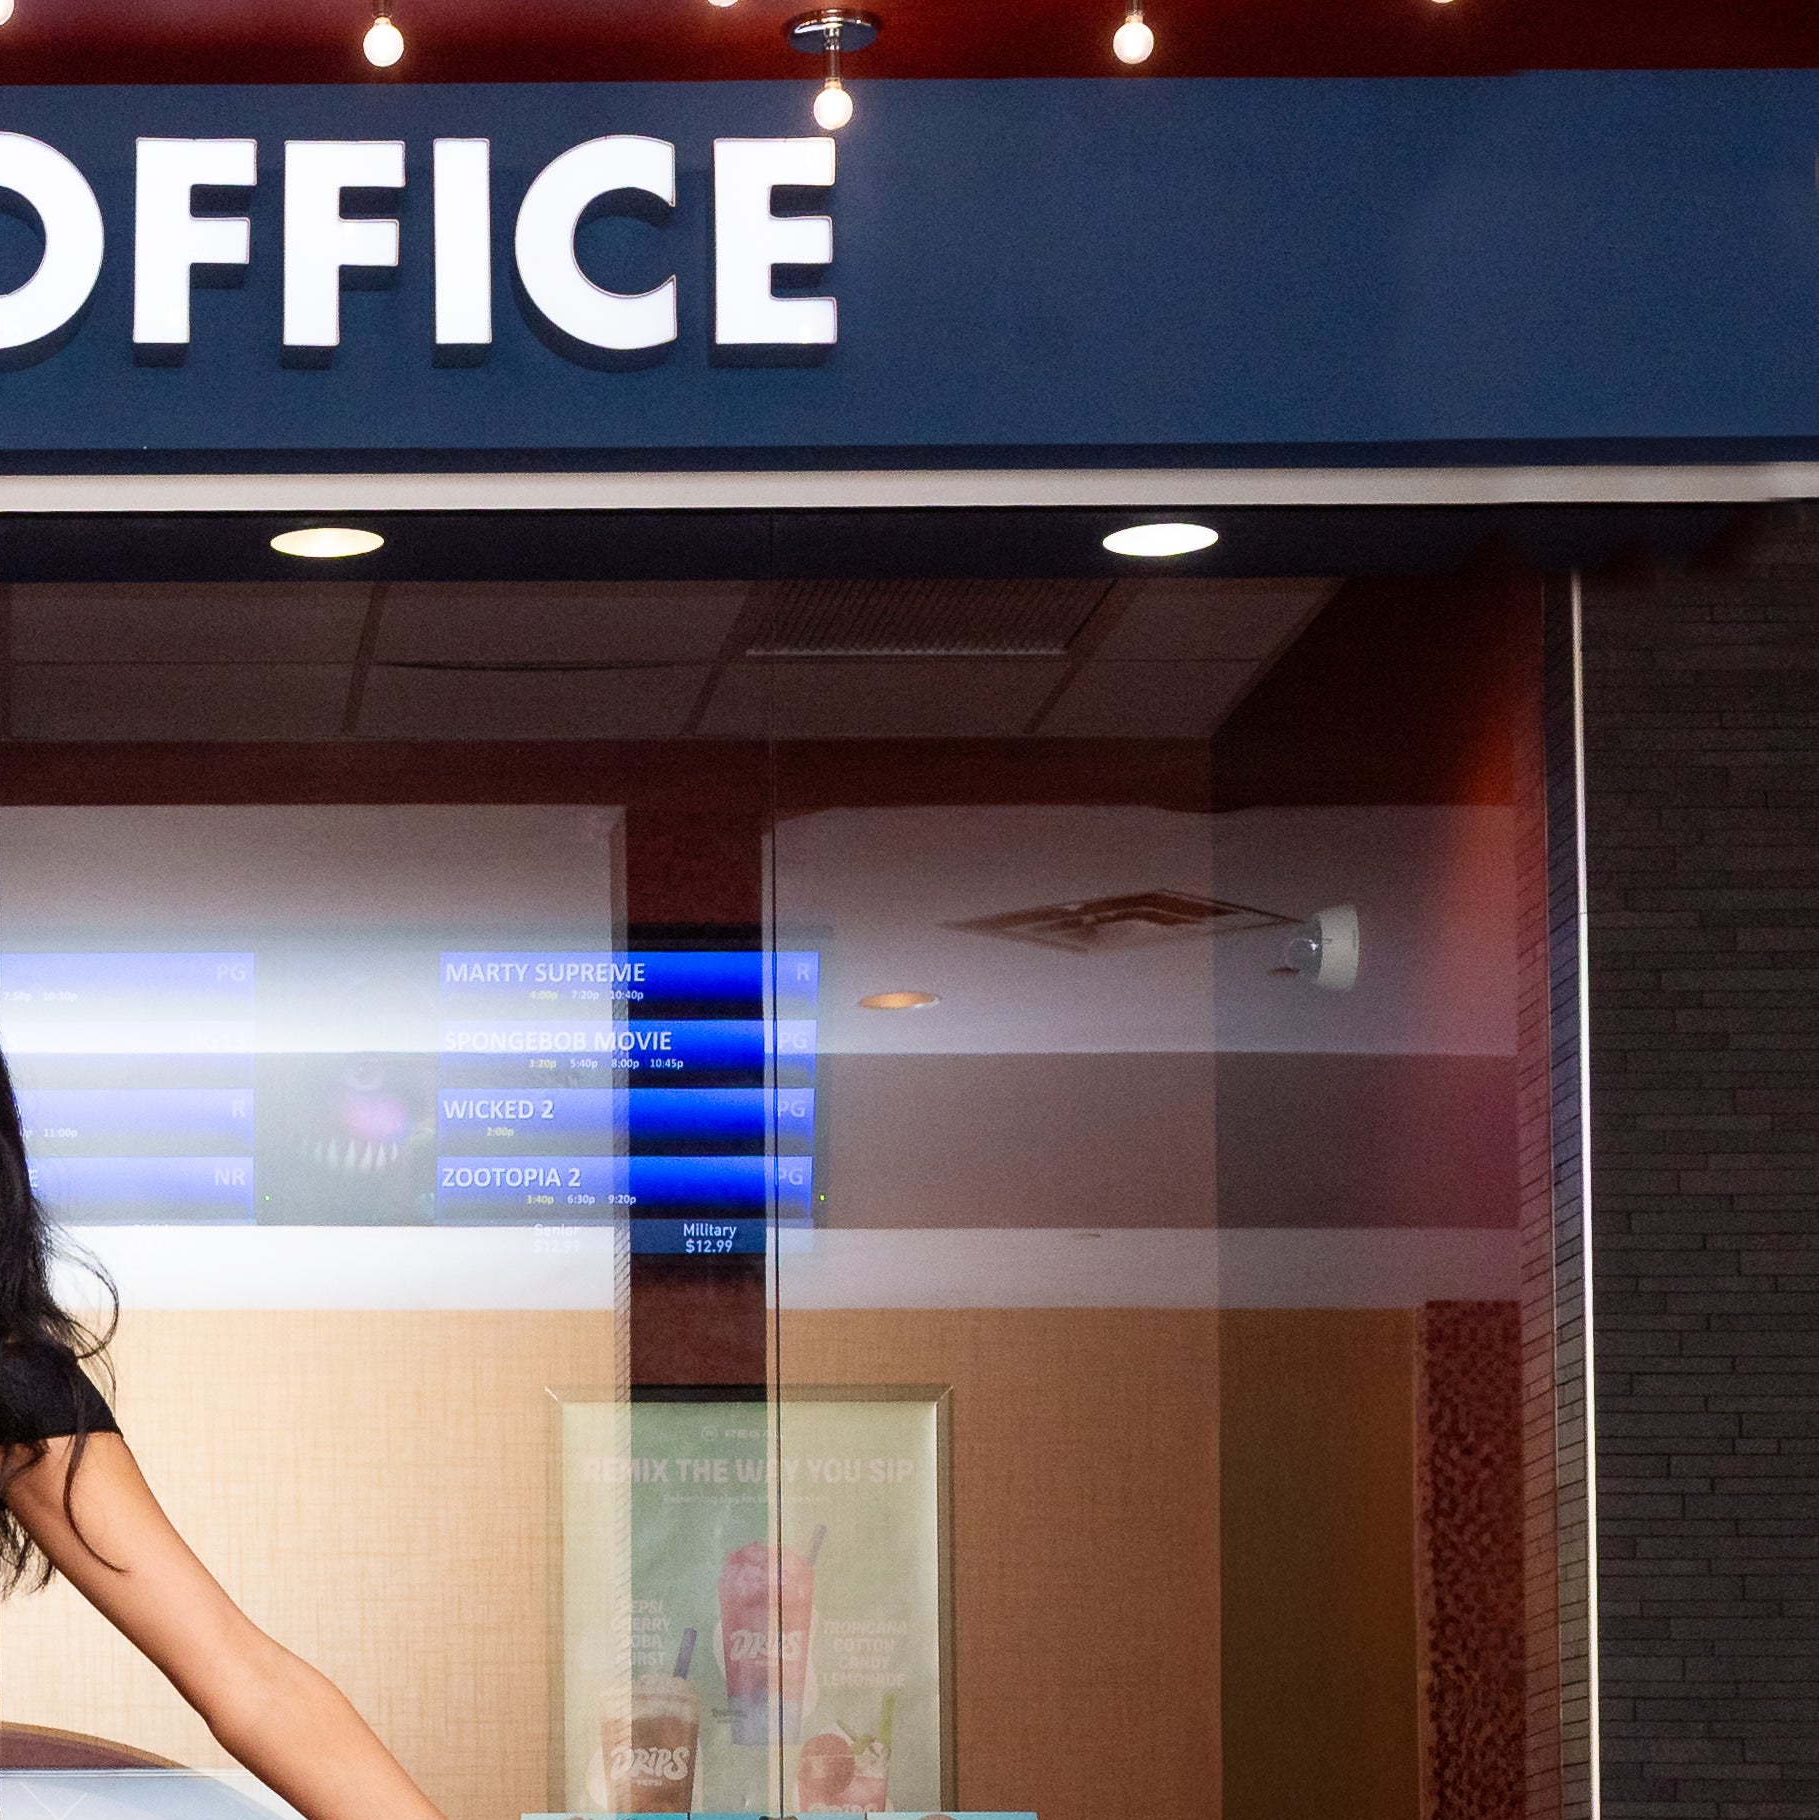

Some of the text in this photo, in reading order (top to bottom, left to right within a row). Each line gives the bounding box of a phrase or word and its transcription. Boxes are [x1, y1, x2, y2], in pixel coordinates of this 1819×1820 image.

[216, 963, 247, 982] PG
[445, 963, 646, 983] MARTY SUPREME
[796, 962, 811, 982] R
[444, 1030, 673, 1052] SPONGEBOB MOVIE
[650, 1058, 684, 1070] 10:45p
[232, 1100, 246, 1118] R
[443, 1100, 555, 1120] WICKED 2
[214, 1167, 246, 1186] NR
[442, 1167, 582, 1187] ZOOTOPIA 2
[607, 1194, 637, 1206] 9:20p
[683, 1222, 737, 1240] Military
[685, 1238, 733, 1254] $12.99
[582, 1457, 670, 1484] REMIX
[675, 1457, 730, 1484] THE
[805, 1457, 862, 1484] YOU
[867, 1457, 916, 1485] SIP
[627, 1600, 664, 1613] EPSI
[833, 1637, 895, 1652] COTTON
[838, 1655, 890, 1670] CANDY
